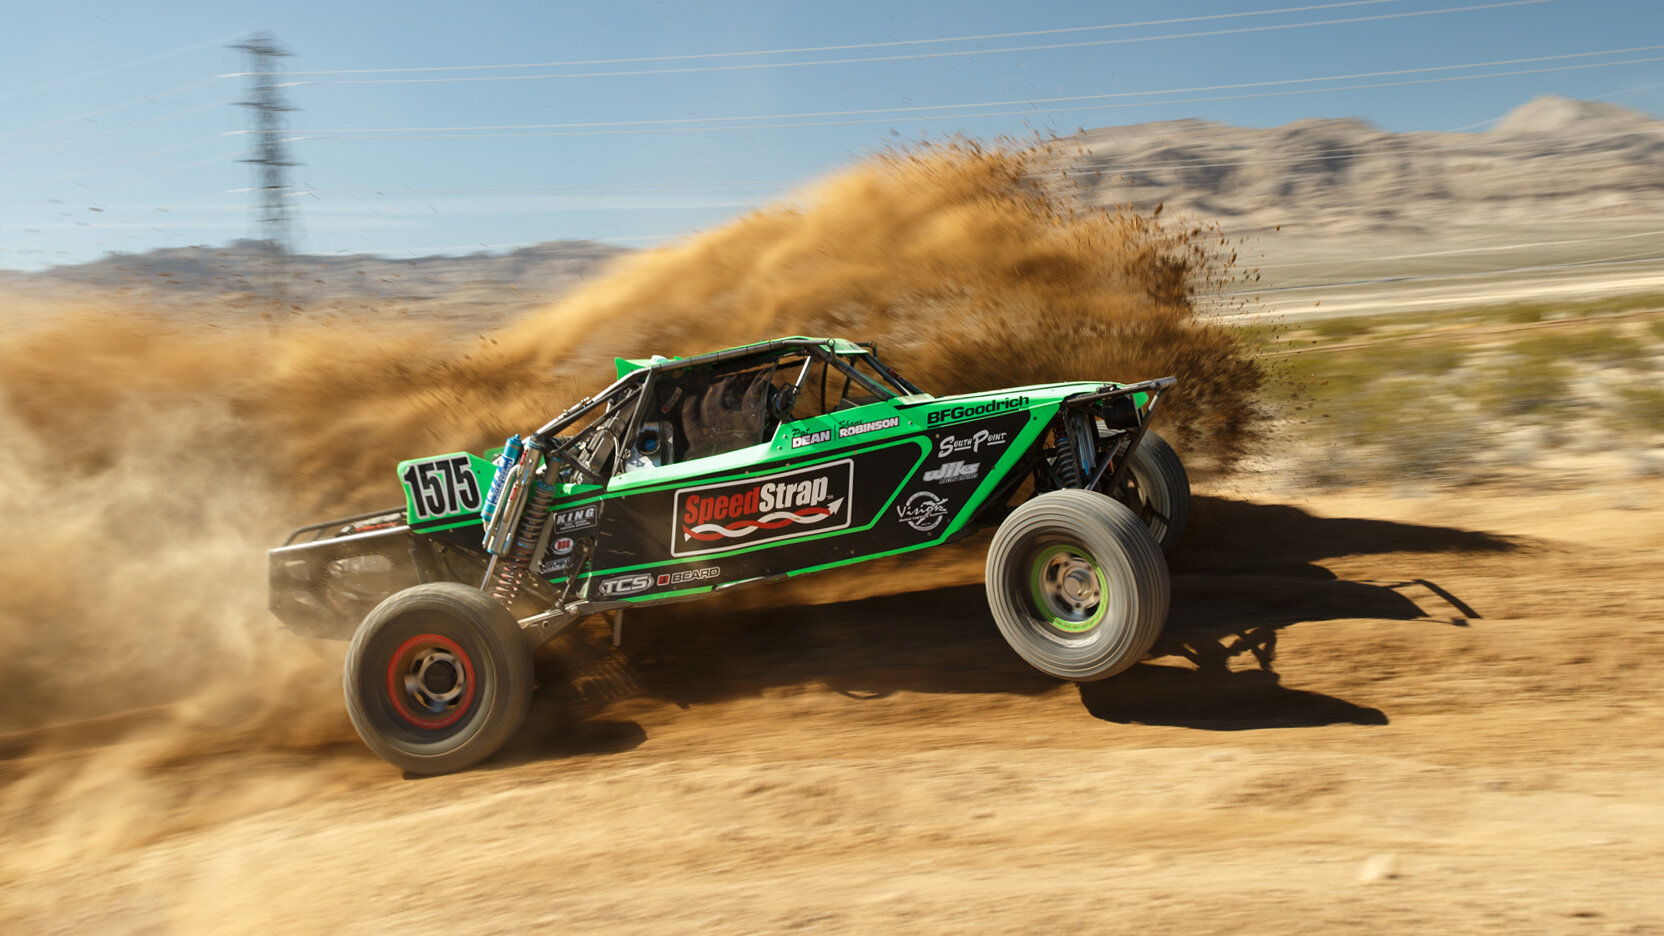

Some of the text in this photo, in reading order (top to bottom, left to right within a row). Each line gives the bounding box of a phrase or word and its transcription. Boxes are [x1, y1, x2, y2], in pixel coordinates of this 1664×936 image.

[927, 396, 1029, 424] BFGoodrich
[839, 416, 899, 438] ROBINSON
[792, 429, 831, 449] DEAN
[402, 455, 482, 519] 1575
[683, 476, 829, 525] SpeedStrap
[556, 508, 595, 525] KING
[603, 576, 650, 594] TCS
[671, 567, 720, 584] BEARD
